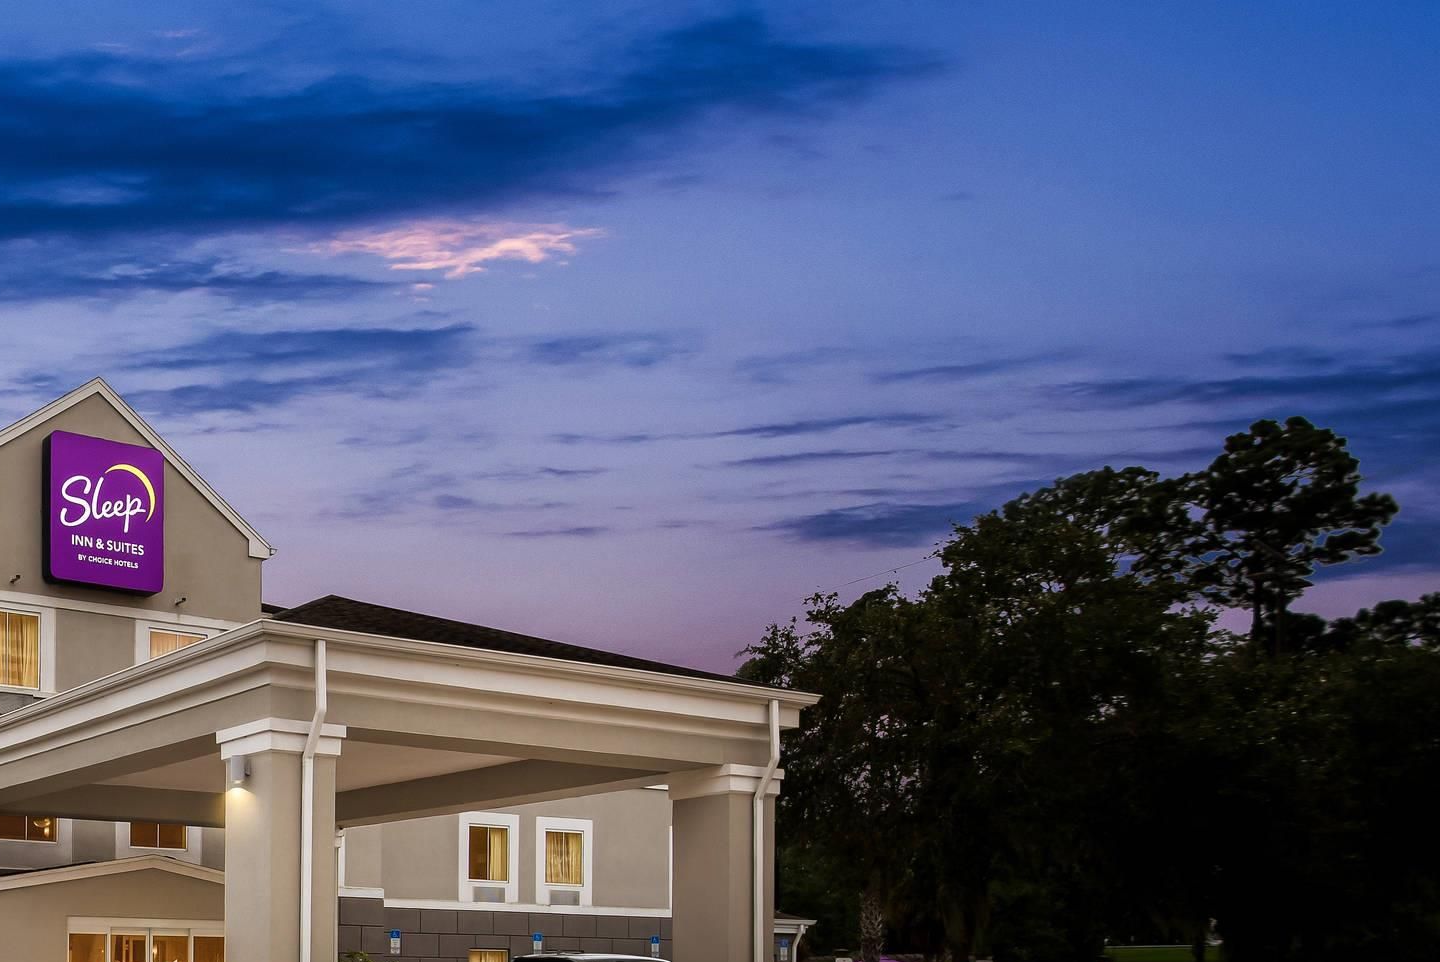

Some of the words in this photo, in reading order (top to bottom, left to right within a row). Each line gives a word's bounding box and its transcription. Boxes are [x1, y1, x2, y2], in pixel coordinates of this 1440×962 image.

[60, 475, 146, 533] Sleep
[71, 534, 93, 548] INN
[95, 538, 105, 550] &
[106, 539, 145, 556] SUITES
[77, 553, 87, 561] BY
[88, 555, 113, 565] CHOICE
[113, 559, 139, 569] HOTELS
